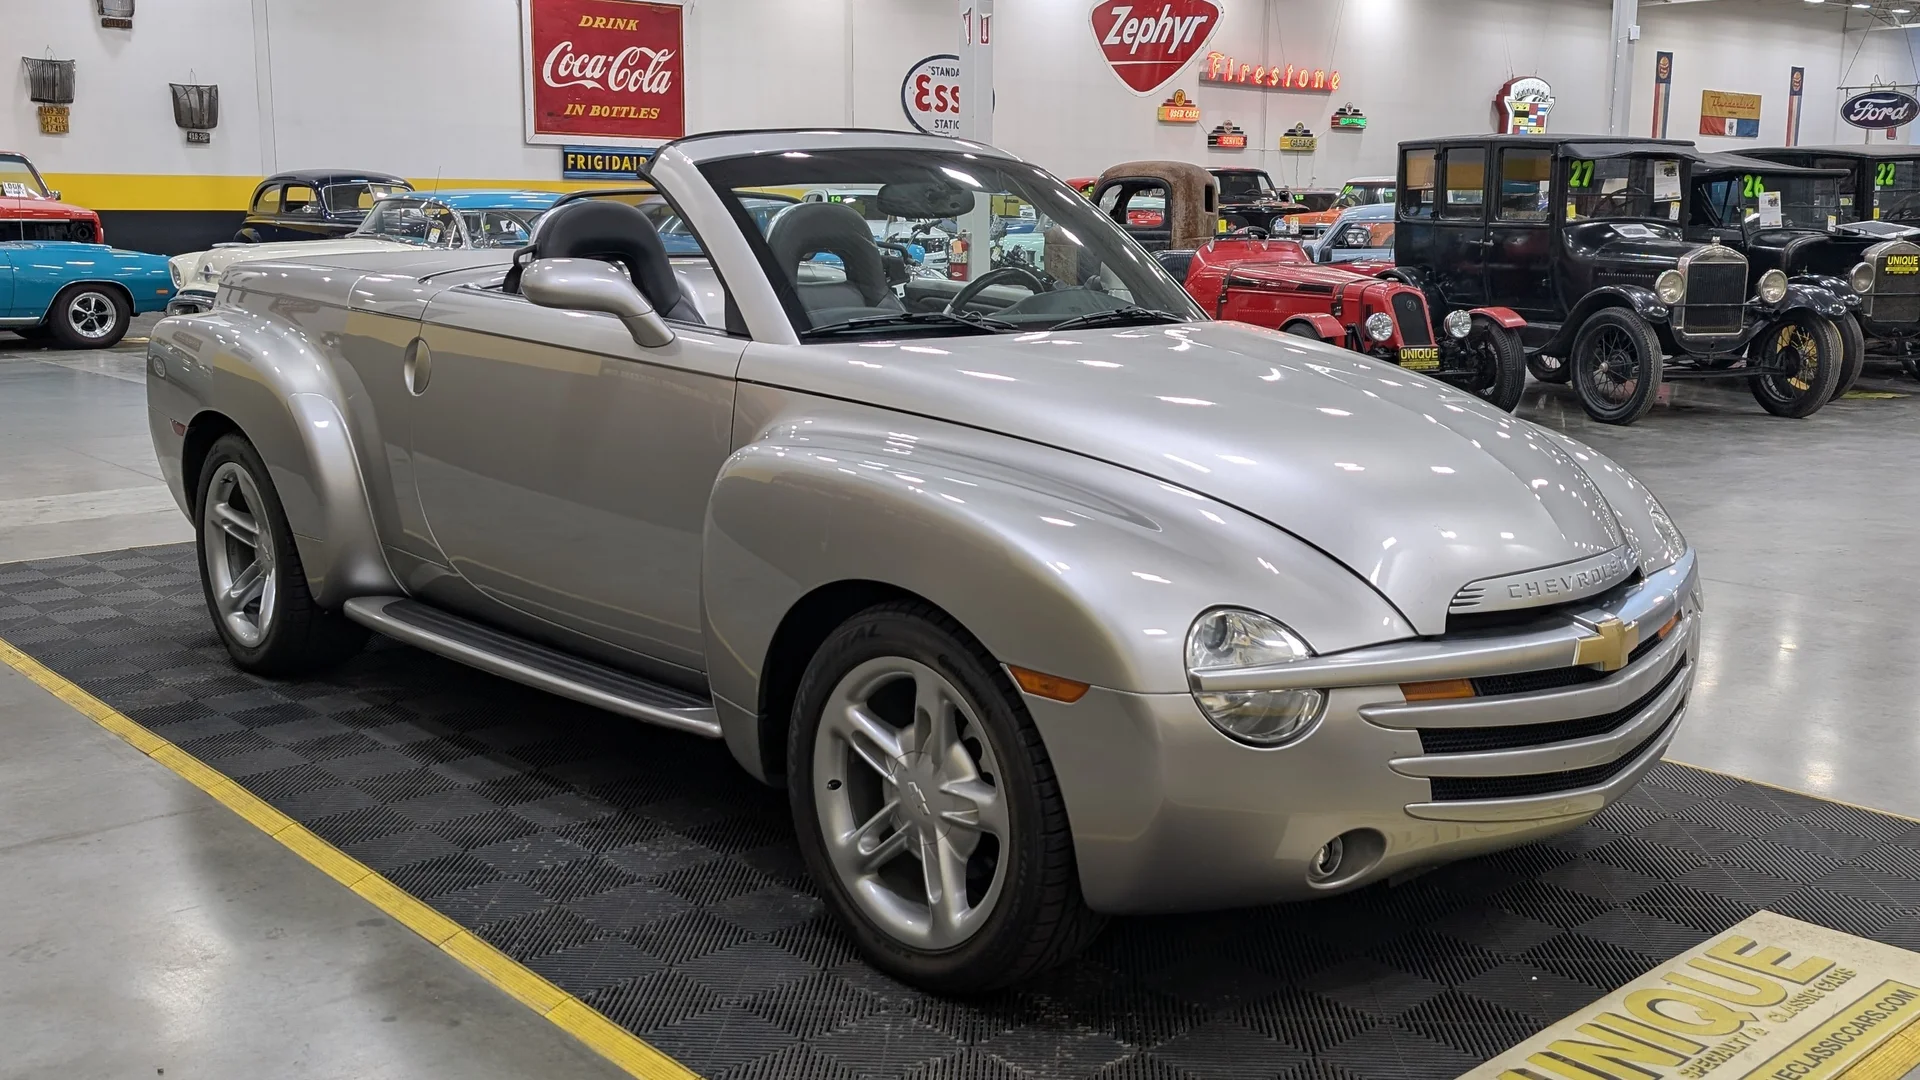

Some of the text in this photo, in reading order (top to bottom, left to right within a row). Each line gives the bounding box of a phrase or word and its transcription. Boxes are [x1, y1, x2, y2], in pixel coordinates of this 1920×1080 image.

[578, 15, 640, 31] DRINK
[1102, 3, 1209, 55] Zephyr
[542, 41, 677, 95] Coca-Cola
[1206, 51, 1341, 90] Firestone
[915, 73, 960, 114] Ess
[564, 103, 661, 120] IN BOTTLES
[1169, 109, 1200, 119] USED CARS
[1849, 98, 1911, 122] Ford
[1222, 136, 1244, 145] SERVICE
[567, 154, 648, 171] FRIGIDAIR
[1569, 160, 1595, 188] 27
[1876, 163, 1896, 186] 22
[1743, 174, 1765, 198] 26
[1887, 255, 1919, 265] UNIQUE
[1400, 348, 1439, 360] UNIQUE
[1506, 555, 1626, 599] CHEVROLET
[1677, 1031, 1758, 1080] SPECIALTY
[1764, 988, 1826, 1024] CLASSIC
[1813, 967, 1858, 993] CARS
